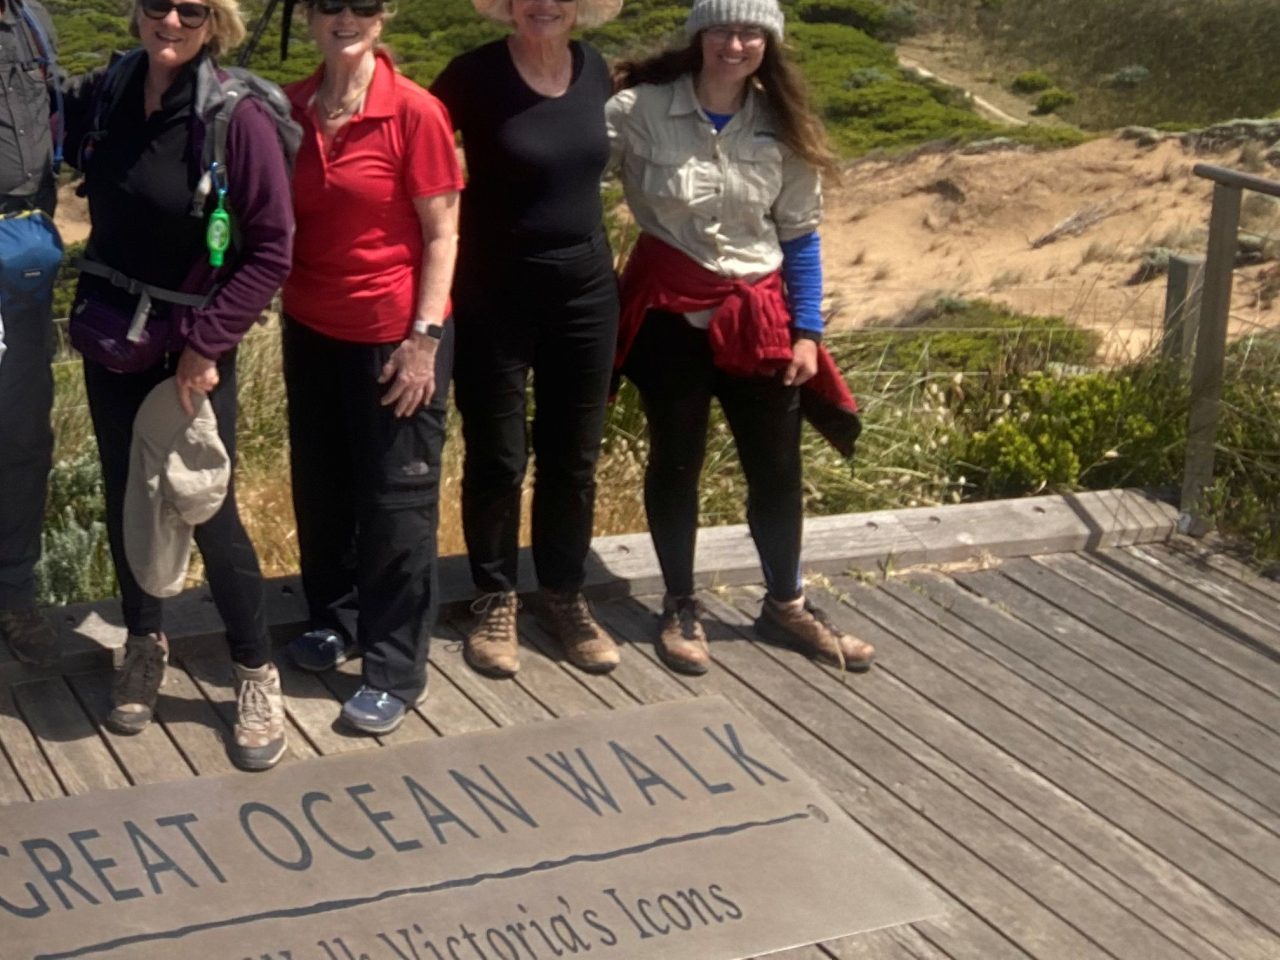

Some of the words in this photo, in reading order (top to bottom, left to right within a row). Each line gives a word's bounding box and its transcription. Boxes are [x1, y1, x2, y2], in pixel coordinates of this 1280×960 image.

[239, 764, 539, 871] OCEAN
[526, 724, 789, 817] WALK
[603, 884, 743, 939] Icons
